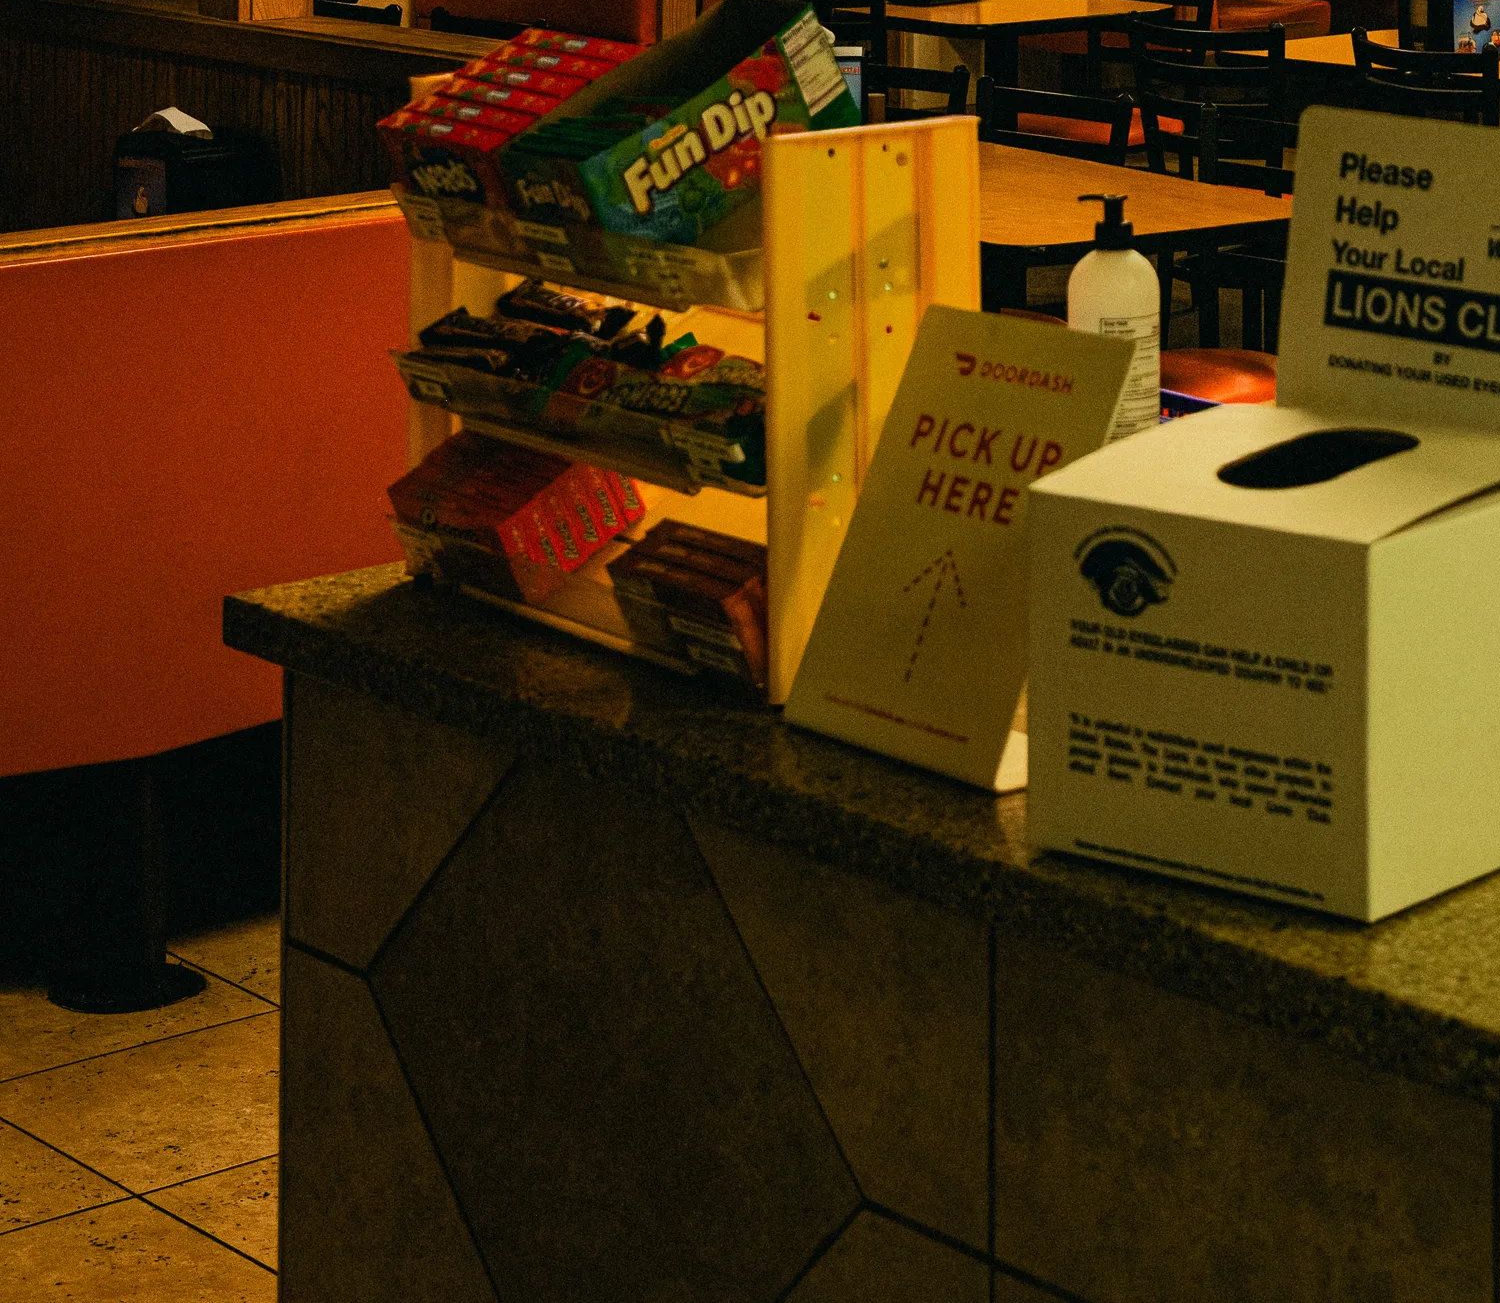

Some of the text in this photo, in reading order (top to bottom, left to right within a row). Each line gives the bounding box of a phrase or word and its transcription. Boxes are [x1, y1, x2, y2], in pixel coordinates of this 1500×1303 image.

[621, 90, 778, 217] Fun Dip
[1339, 151, 1434, 191] Please
[1335, 195, 1400, 234] Help
[1332, 239, 1465, 282] Your Local
[1332, 281, 1447, 333] LIONS
[978, 361, 1074, 395] DOORDASH
[1328, 354, 1393, 377] DONATING
[1395, 364, 1433, 383] YOUR
[1435, 371, 1470, 391] USED
[1432, 350, 1453, 366] BY
[910, 413, 1064, 476] PICK UP
[915, 468, 1021, 526] HERE
